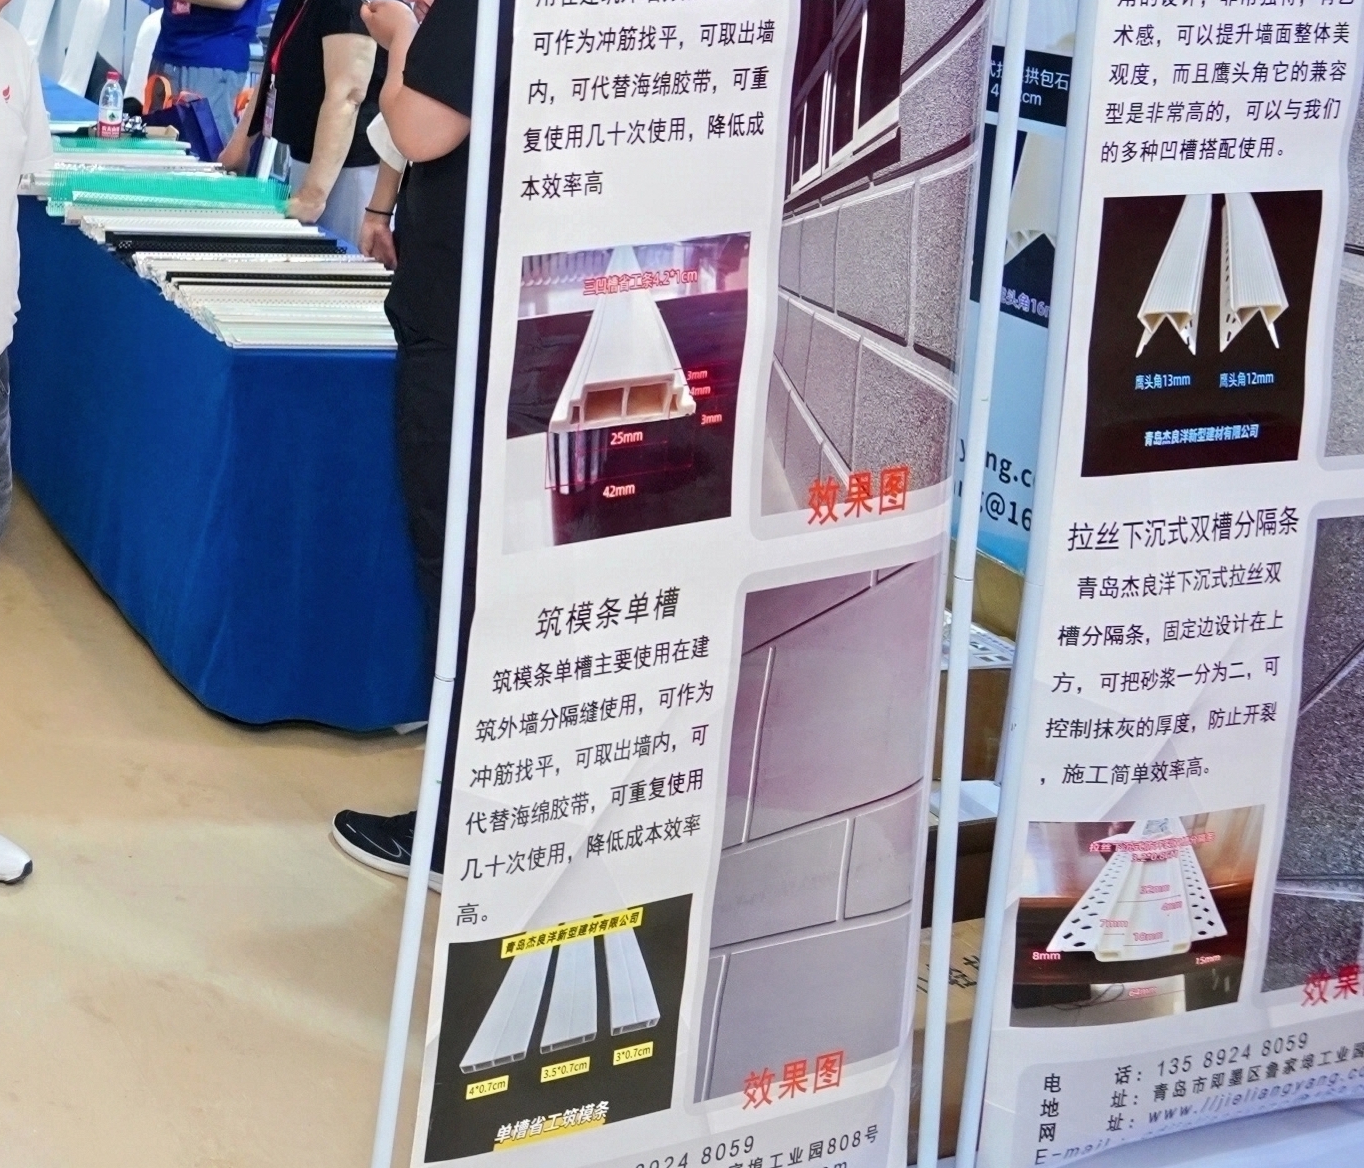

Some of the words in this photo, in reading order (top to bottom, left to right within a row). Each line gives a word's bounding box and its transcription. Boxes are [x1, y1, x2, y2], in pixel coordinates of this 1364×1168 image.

[533, 18, 775, 58] 可作为冲筋找平，可取出墙
[1113, 21, 1350, 47] 术感，可以提升墙面整体美
[528, 64, 769, 106] 内，可代替海绵胶带，可重
[1109, 60, 1347, 87] 观度，而且鹰头角它的兼容
[1105, 98, 1341, 126] 型是非常高的，可以与我们
[523, 110, 764, 155] 复使用几十次使用，降低成
[1100, 136, 1286, 164] 的多种凹槽搭配使用。
[520, 169, 604, 202] 本效率高
[686, 368, 708, 382] 3mm
[1135, 373, 1191, 390] 鹰头角13mm
[1219, 371, 1274, 388] 鹰头角12mm
[611, 429, 644, 447] 25mm
[701, 412, 723, 426] 3mm
[1144, 424, 1259, 447] 青岛杰良洋新型建材有限公司
[603, 481, 636, 499] 42mm
[807, 464, 910, 525] 效果图
[1068, 505, 1300, 552] 拉丝下沉式双槽分隔条
[1077, 561, 1282, 600] 青岛杰良洋下沉式拉丝双
[535, 586, 682, 640] 筑模条单槽
[1058, 609, 1284, 647] 槽分隔条，固定边设计在上
[492, 635, 710, 696] 筑模条单槽主要使用在建
[1051, 655, 1281, 694] 方，可把砂浆一分为二，可
[475, 681, 714, 743] 筑外墙分隔缝使用，可作为
[1045, 701, 1277, 740] 控制抹灰的厚度，防止开裂
[469, 724, 709, 789] 冲筋找平，可取出墙内，可
[466, 768, 703, 836] 代替海绵胶带，可重复使用
[460, 813, 701, 882] 几十次使用，降低成本效率
[456, 903, 488, 926] 高。
[504, 910, 641, 956] 青岛杰良洋新型建材有限公司
[1032, 952, 1061, 961] 8mm
[1195, 954, 1221, 965] 15mm
[1301, 963, 1364, 1007] 效果
[1157, 1054, 1192, 1076] 135
[1203, 1043, 1252, 1068] 8924
[1261, 1032, 1309, 1057] 8059
[742, 1049, 845, 1110] 效果图
[494, 1100, 610, 1144] 单槽省工筑模条
[701, 1136, 755, 1165] 8059
